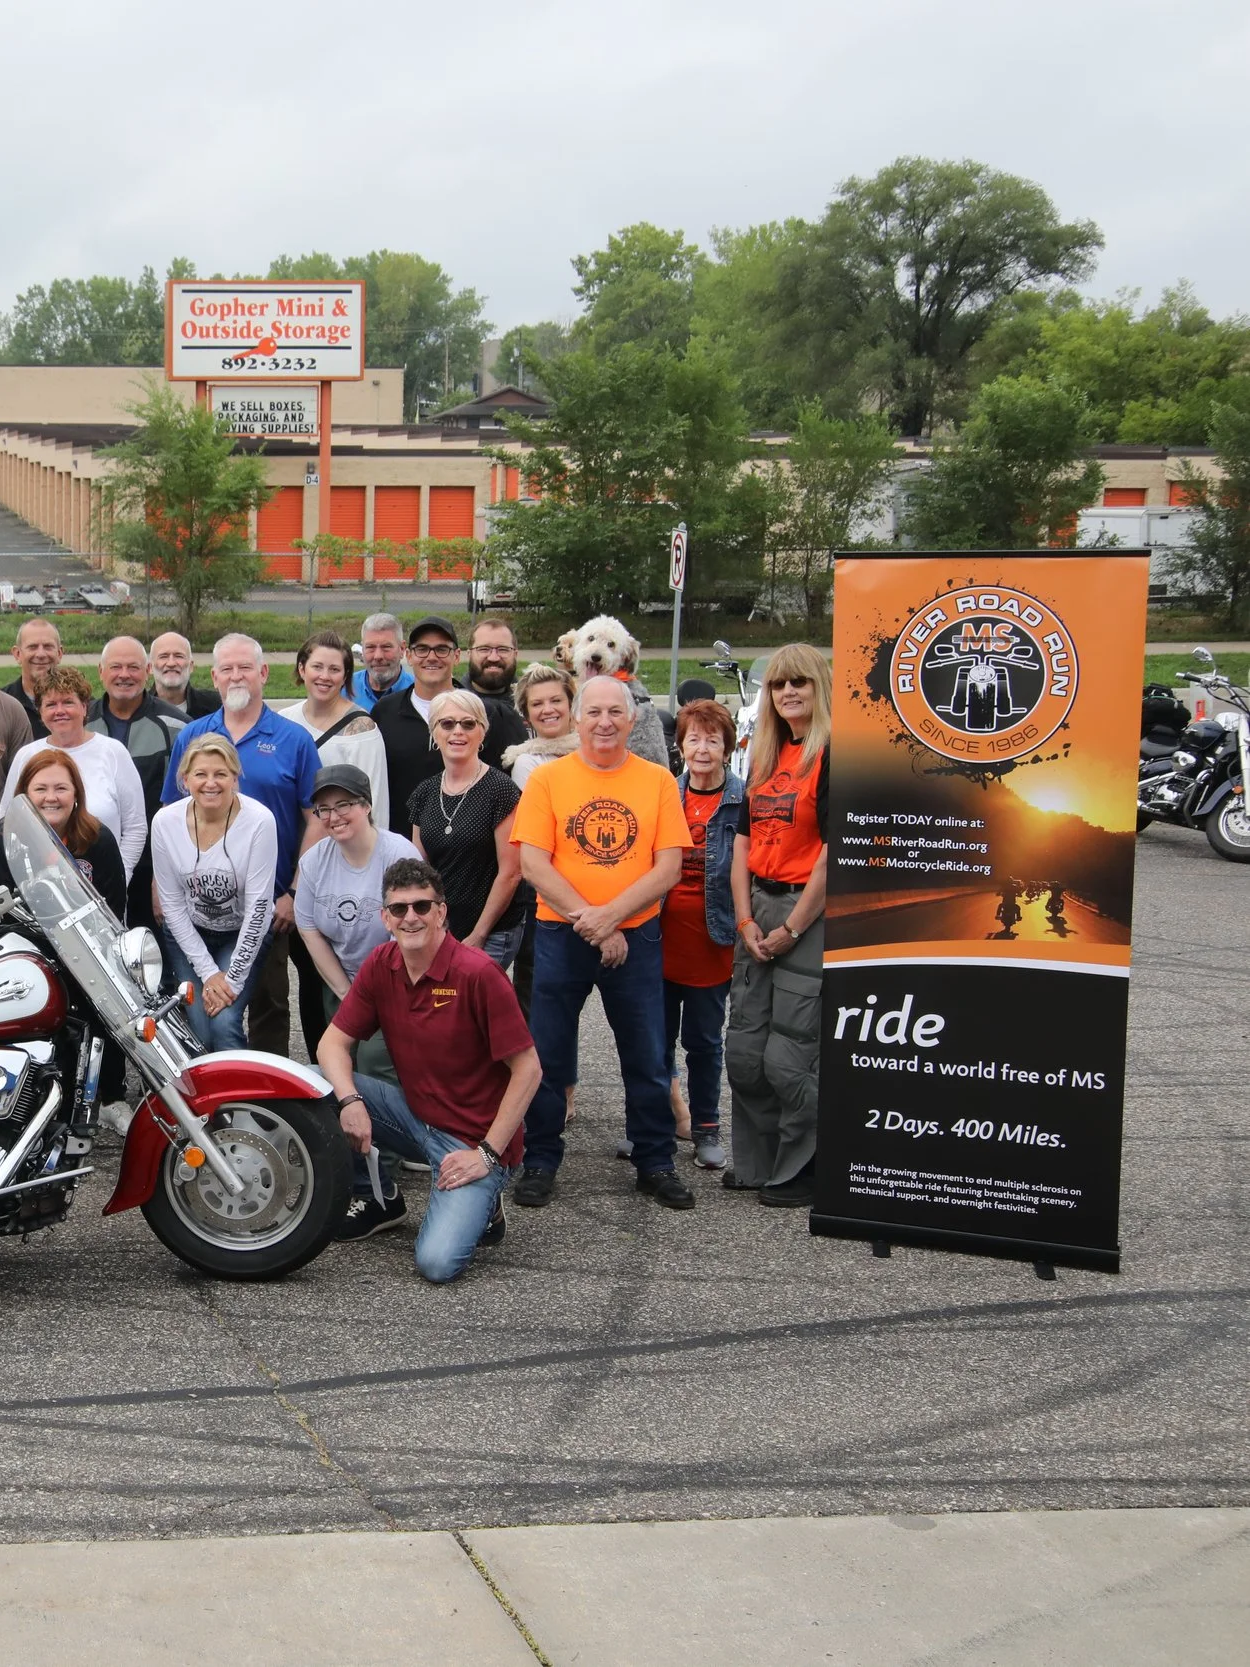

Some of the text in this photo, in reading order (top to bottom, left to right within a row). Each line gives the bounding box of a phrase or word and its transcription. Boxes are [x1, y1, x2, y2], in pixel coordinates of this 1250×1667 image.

[190, 297, 348, 321] Gopher Mini &
[181, 320, 351, 344] Outside Storage
[221, 401, 235, 411] WE
[240, 401, 264, 411] SELL
[283, 412, 305, 422] AND
[216, 423, 314, 433] OVING SUPPLIES!
[897, 593, 1071, 697] RIVER ROAD RUN
[959, 622, 1014, 653] MS
[919, 718, 1039, 754] SINCE 1986
[576, 801, 636, 836] RIVER ROAD RUN
[598, 812, 616, 821] MS
[846, 812, 985, 828] Register TODAY online at:
[842, 836, 988, 853] www.MSRiverRoadRun.org
[907, 850, 920, 858] or
[837, 857, 991, 875] www.MSMotorcycleRide.org
[834, 994, 945, 1047] ride
[851, 1053, 1105, 1090] toward a world free of MS
[864, 1109, 1067, 1148] 2 Days. 400 Miles.
[849, 1163, 866, 1172] Join
[868, 1165, 882, 1173] the
[882, 1168, 918, 1180] growing
[919, 1172, 963, 1183] movement
[965, 1176, 974, 1184] to
[976, 1177, 992, 1186] end
[994, 1180, 1030, 1191] multiple
[1031, 1183, 1068, 1195] sclerosis
[850, 1174, 865, 1183] this
[866, 1177, 923, 1189] unforgettable
[925, 1183, 942, 1191] ride
[943, 1184, 982, 1198] featuring
[984, 1188, 1039, 1205] breathtaking
[849, 1186, 1038, 1214] mechanical support, and overnight festivities.
